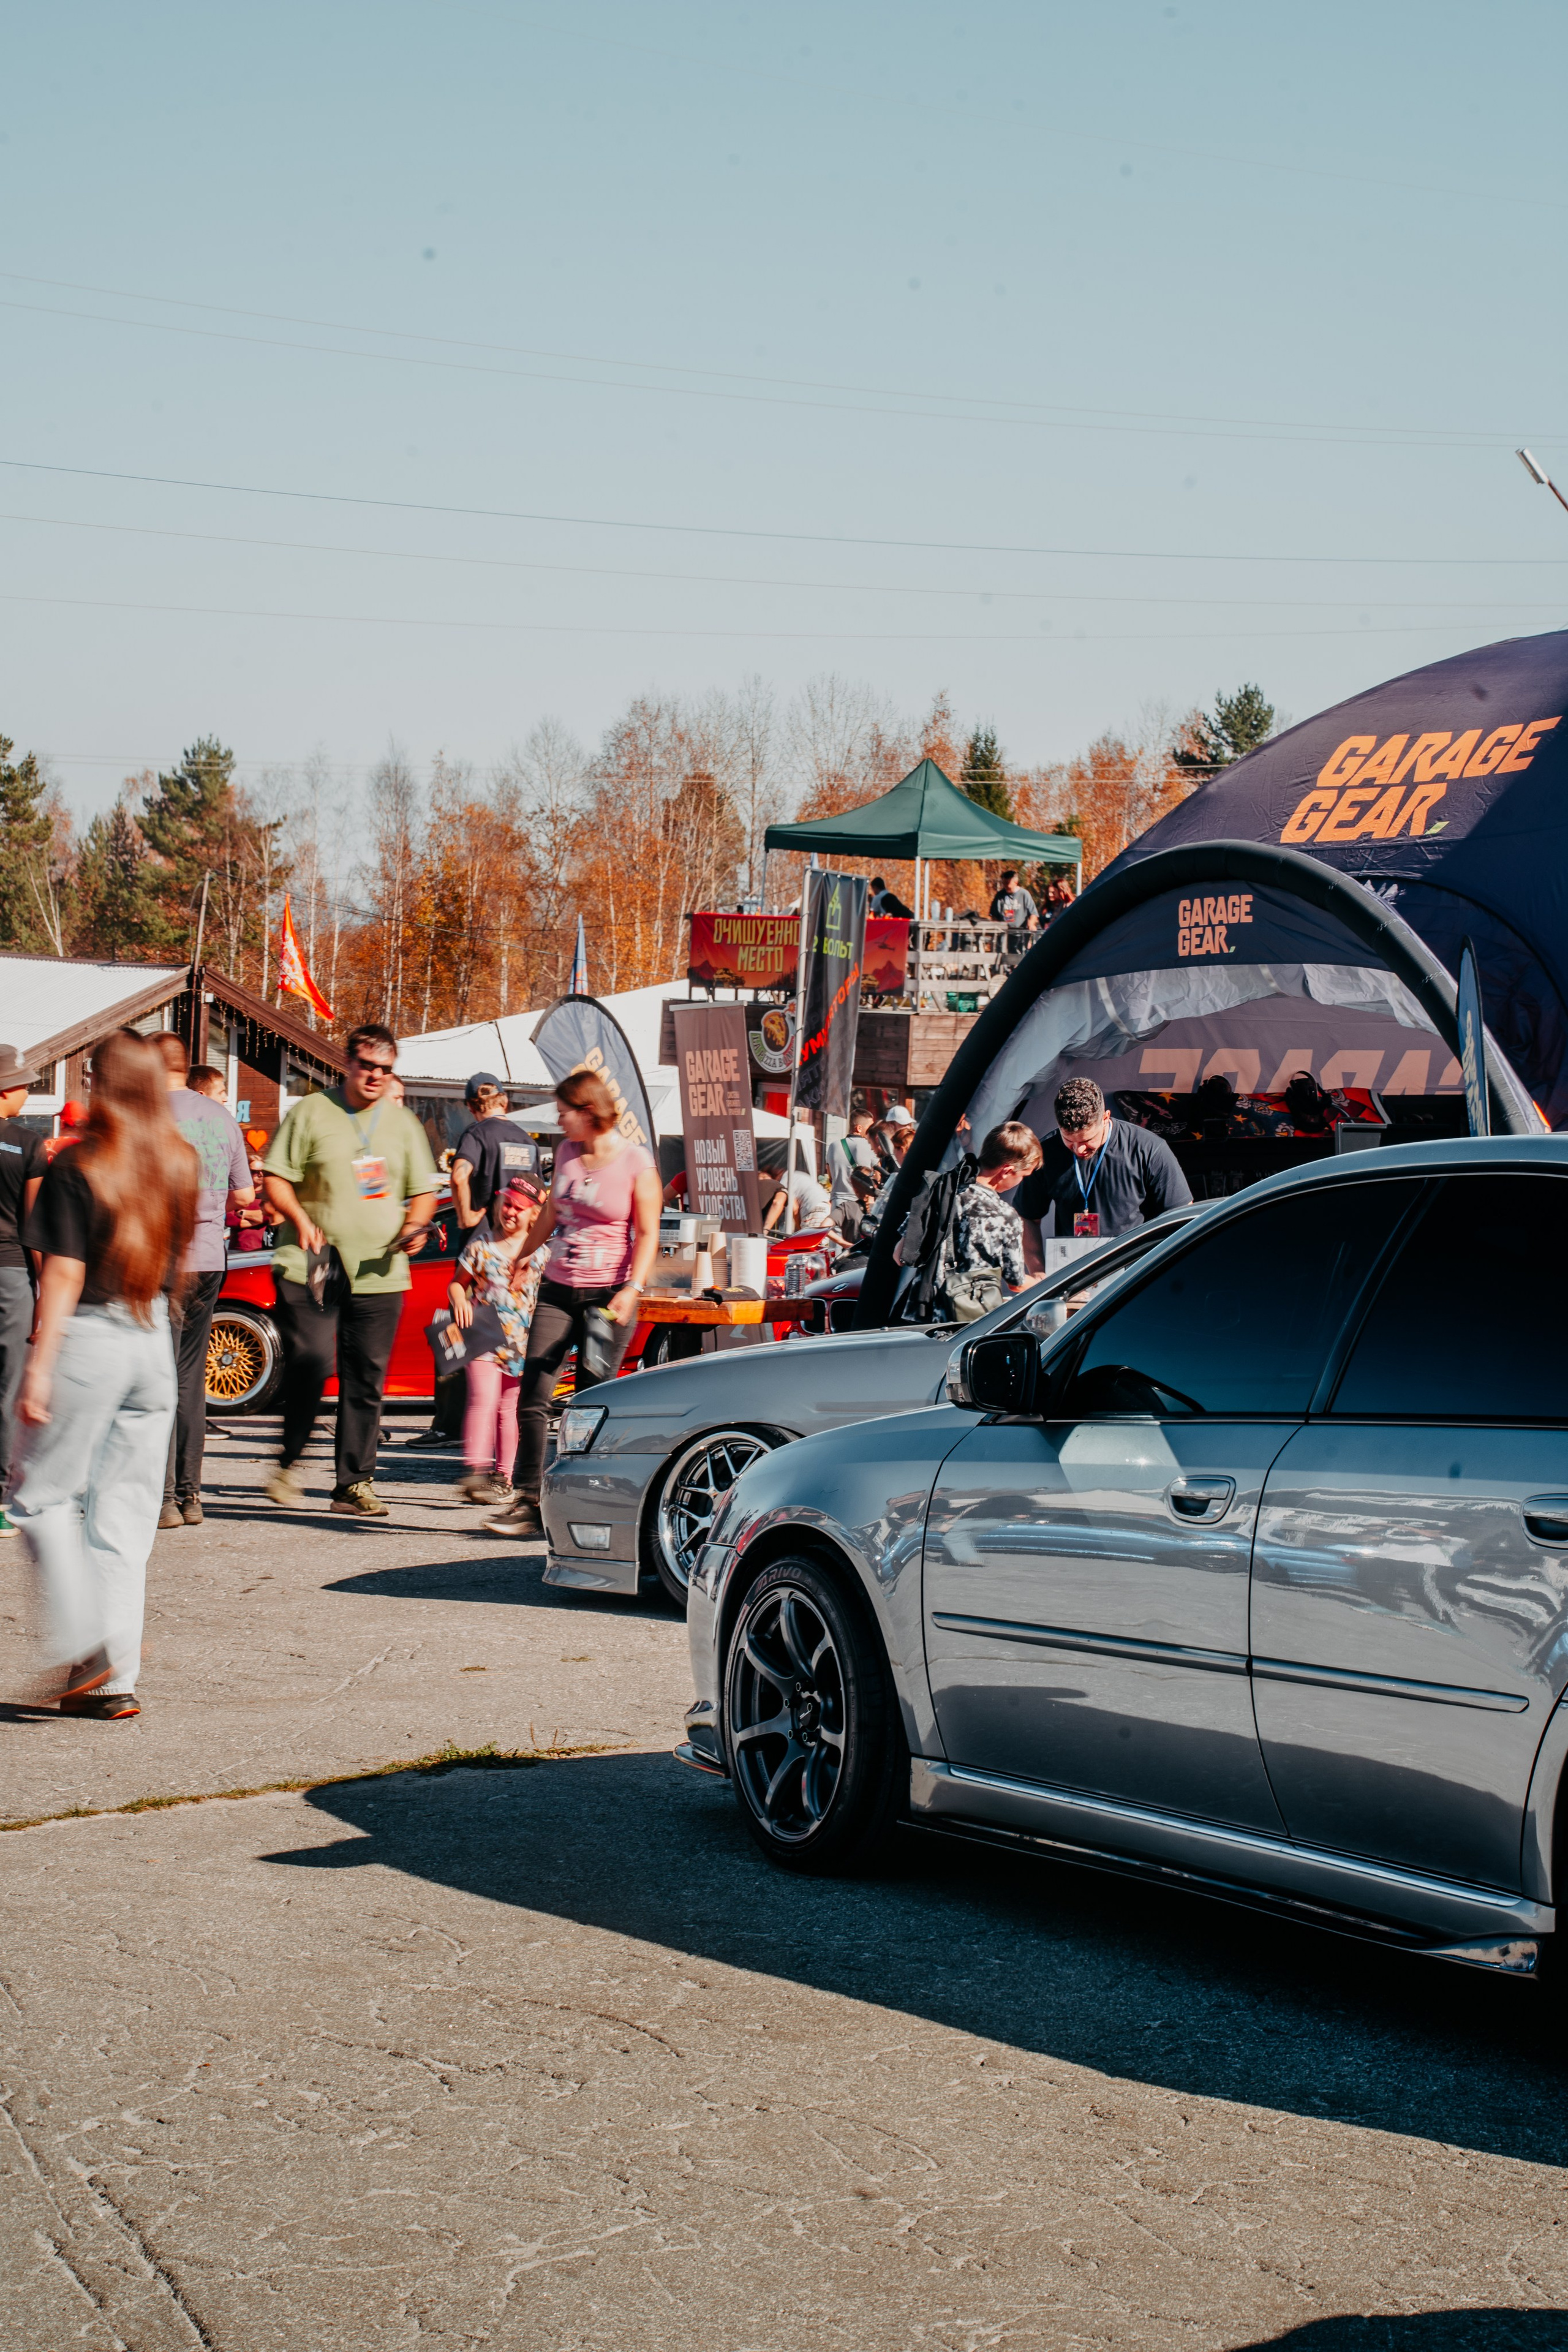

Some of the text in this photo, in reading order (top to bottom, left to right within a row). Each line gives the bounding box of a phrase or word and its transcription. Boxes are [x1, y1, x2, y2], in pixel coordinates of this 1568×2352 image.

[1316, 715, 1562, 787] GARAGE
[1280, 783, 1447, 843] GEAR
[1178, 894, 1253, 927] GARAGE
[823, 937, 853, 959] ВОЛЬТ
[1178, 925, 1230, 956] GEAR
[737, 946, 783, 973] МЕСТО
[685, 1049, 741, 1083] GARAGE
[758, 1050, 777, 1068] PIZZA
[236, 1101, 251, 1123] Я
[688, 1084, 728, 1117] GEAR
[694, 1134, 728, 1164] НОВЫЙ
[696, 1167, 739, 1191] УРОВЕНЬ
